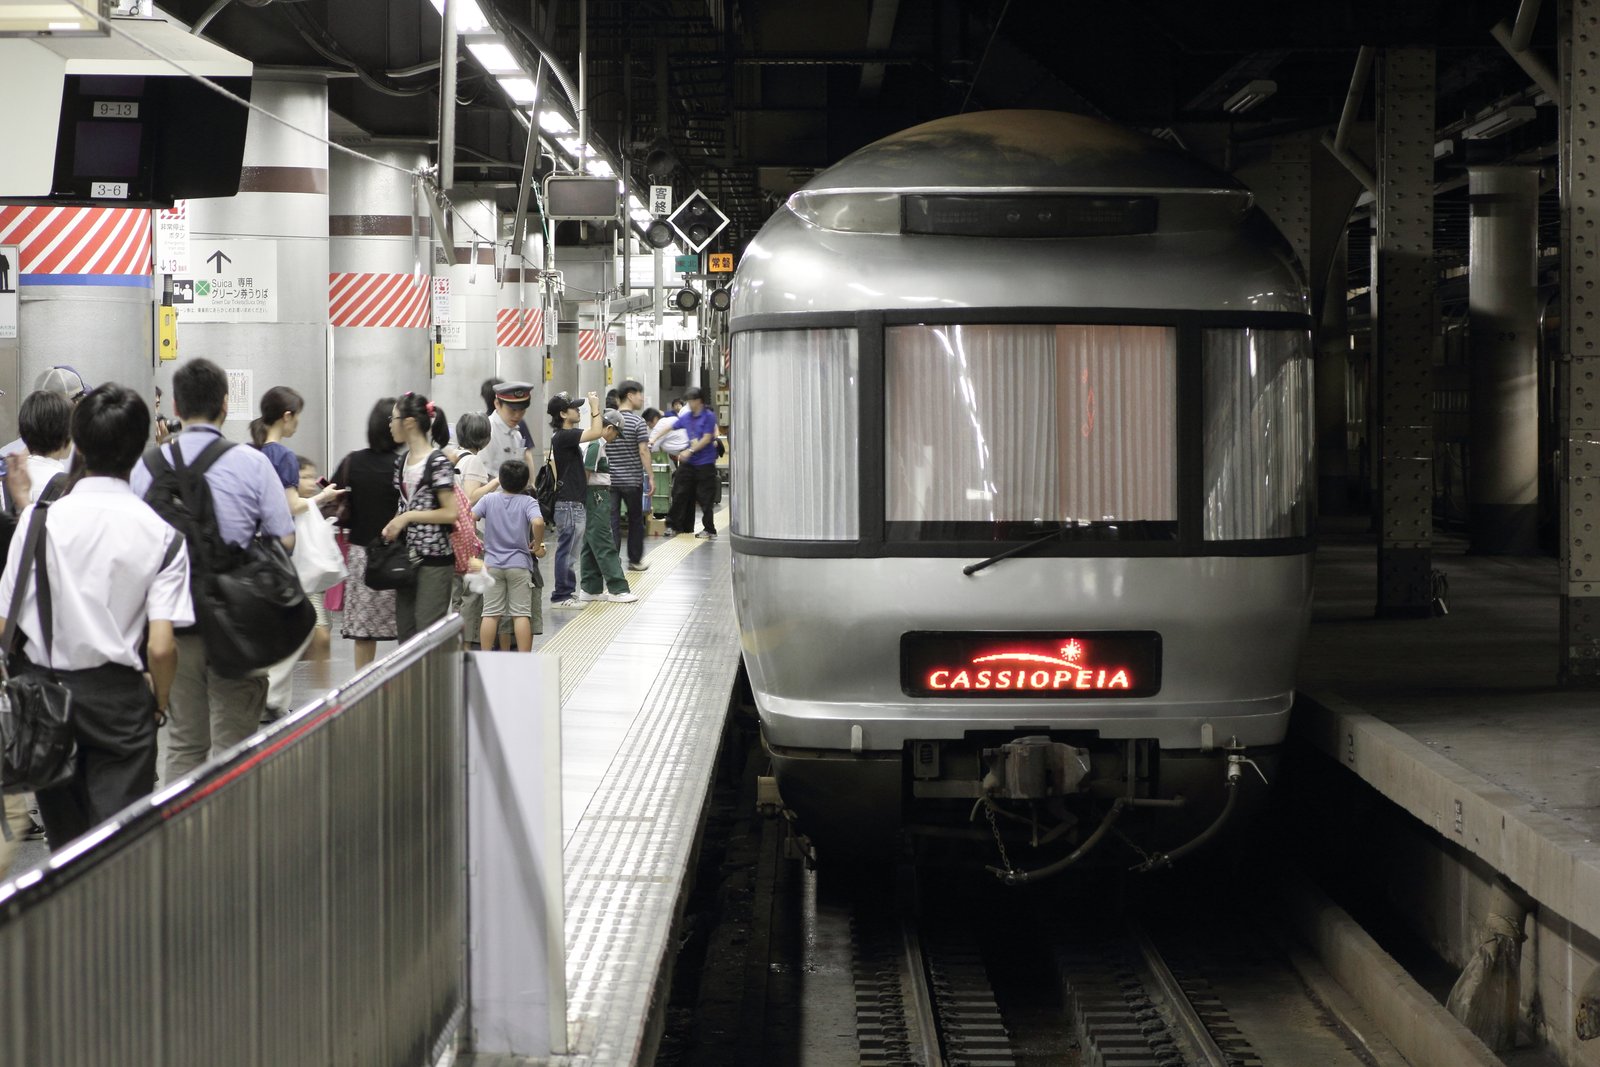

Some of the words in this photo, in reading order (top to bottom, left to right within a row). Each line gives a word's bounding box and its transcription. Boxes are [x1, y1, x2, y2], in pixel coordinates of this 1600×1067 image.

[100, 103, 132, 116] 9-13
[97, 184, 122, 196] 3-6
[160, 223, 185, 231] 非常停止
[168, 259, 177, 272] 13
[712, 257, 730, 268] 常磐
[211, 278, 233, 288] Suica
[238, 277, 253, 288] 専用
[211, 289, 269, 300] グリーン券うりば
[929, 670, 1130, 690] CASSIOPEIA
